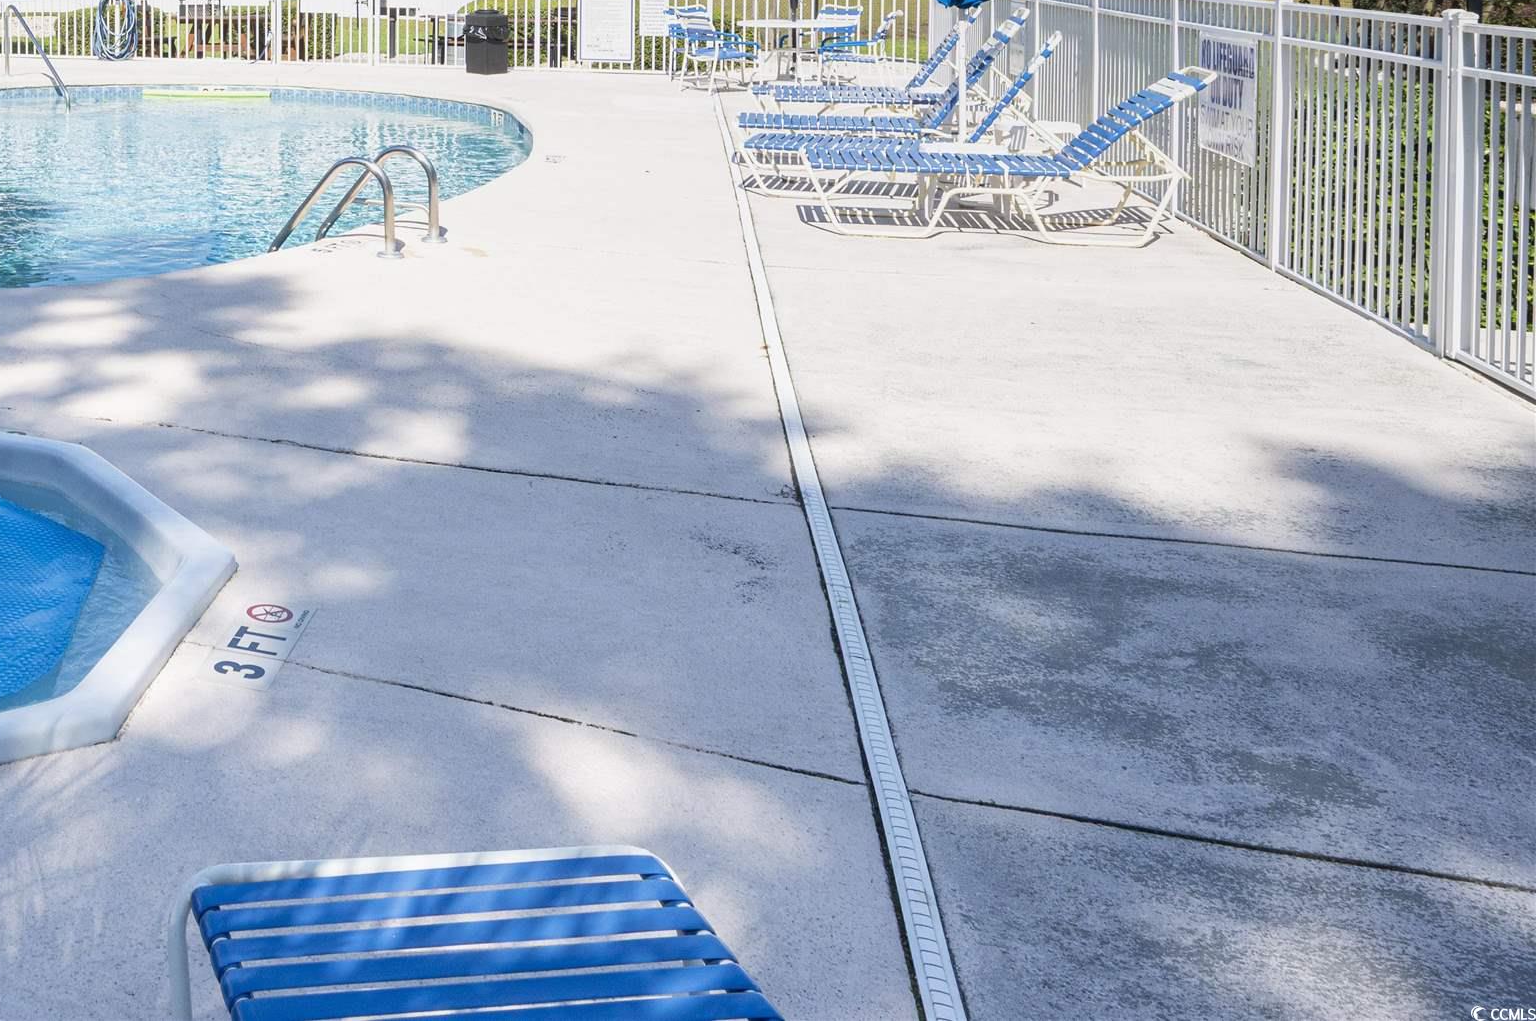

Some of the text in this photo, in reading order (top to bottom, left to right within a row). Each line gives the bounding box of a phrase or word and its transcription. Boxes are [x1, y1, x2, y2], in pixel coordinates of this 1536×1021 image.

[1201, 39, 1255, 79] NO LIFEGUARD
[1210, 74, 1243, 110] ON DUTY
[1201, 104, 1221, 129] SWIM
[1231, 114, 1253, 139] YOUR
[1226, 135, 1244, 158] RISK
[214, 625, 287, 679] 3 FT
